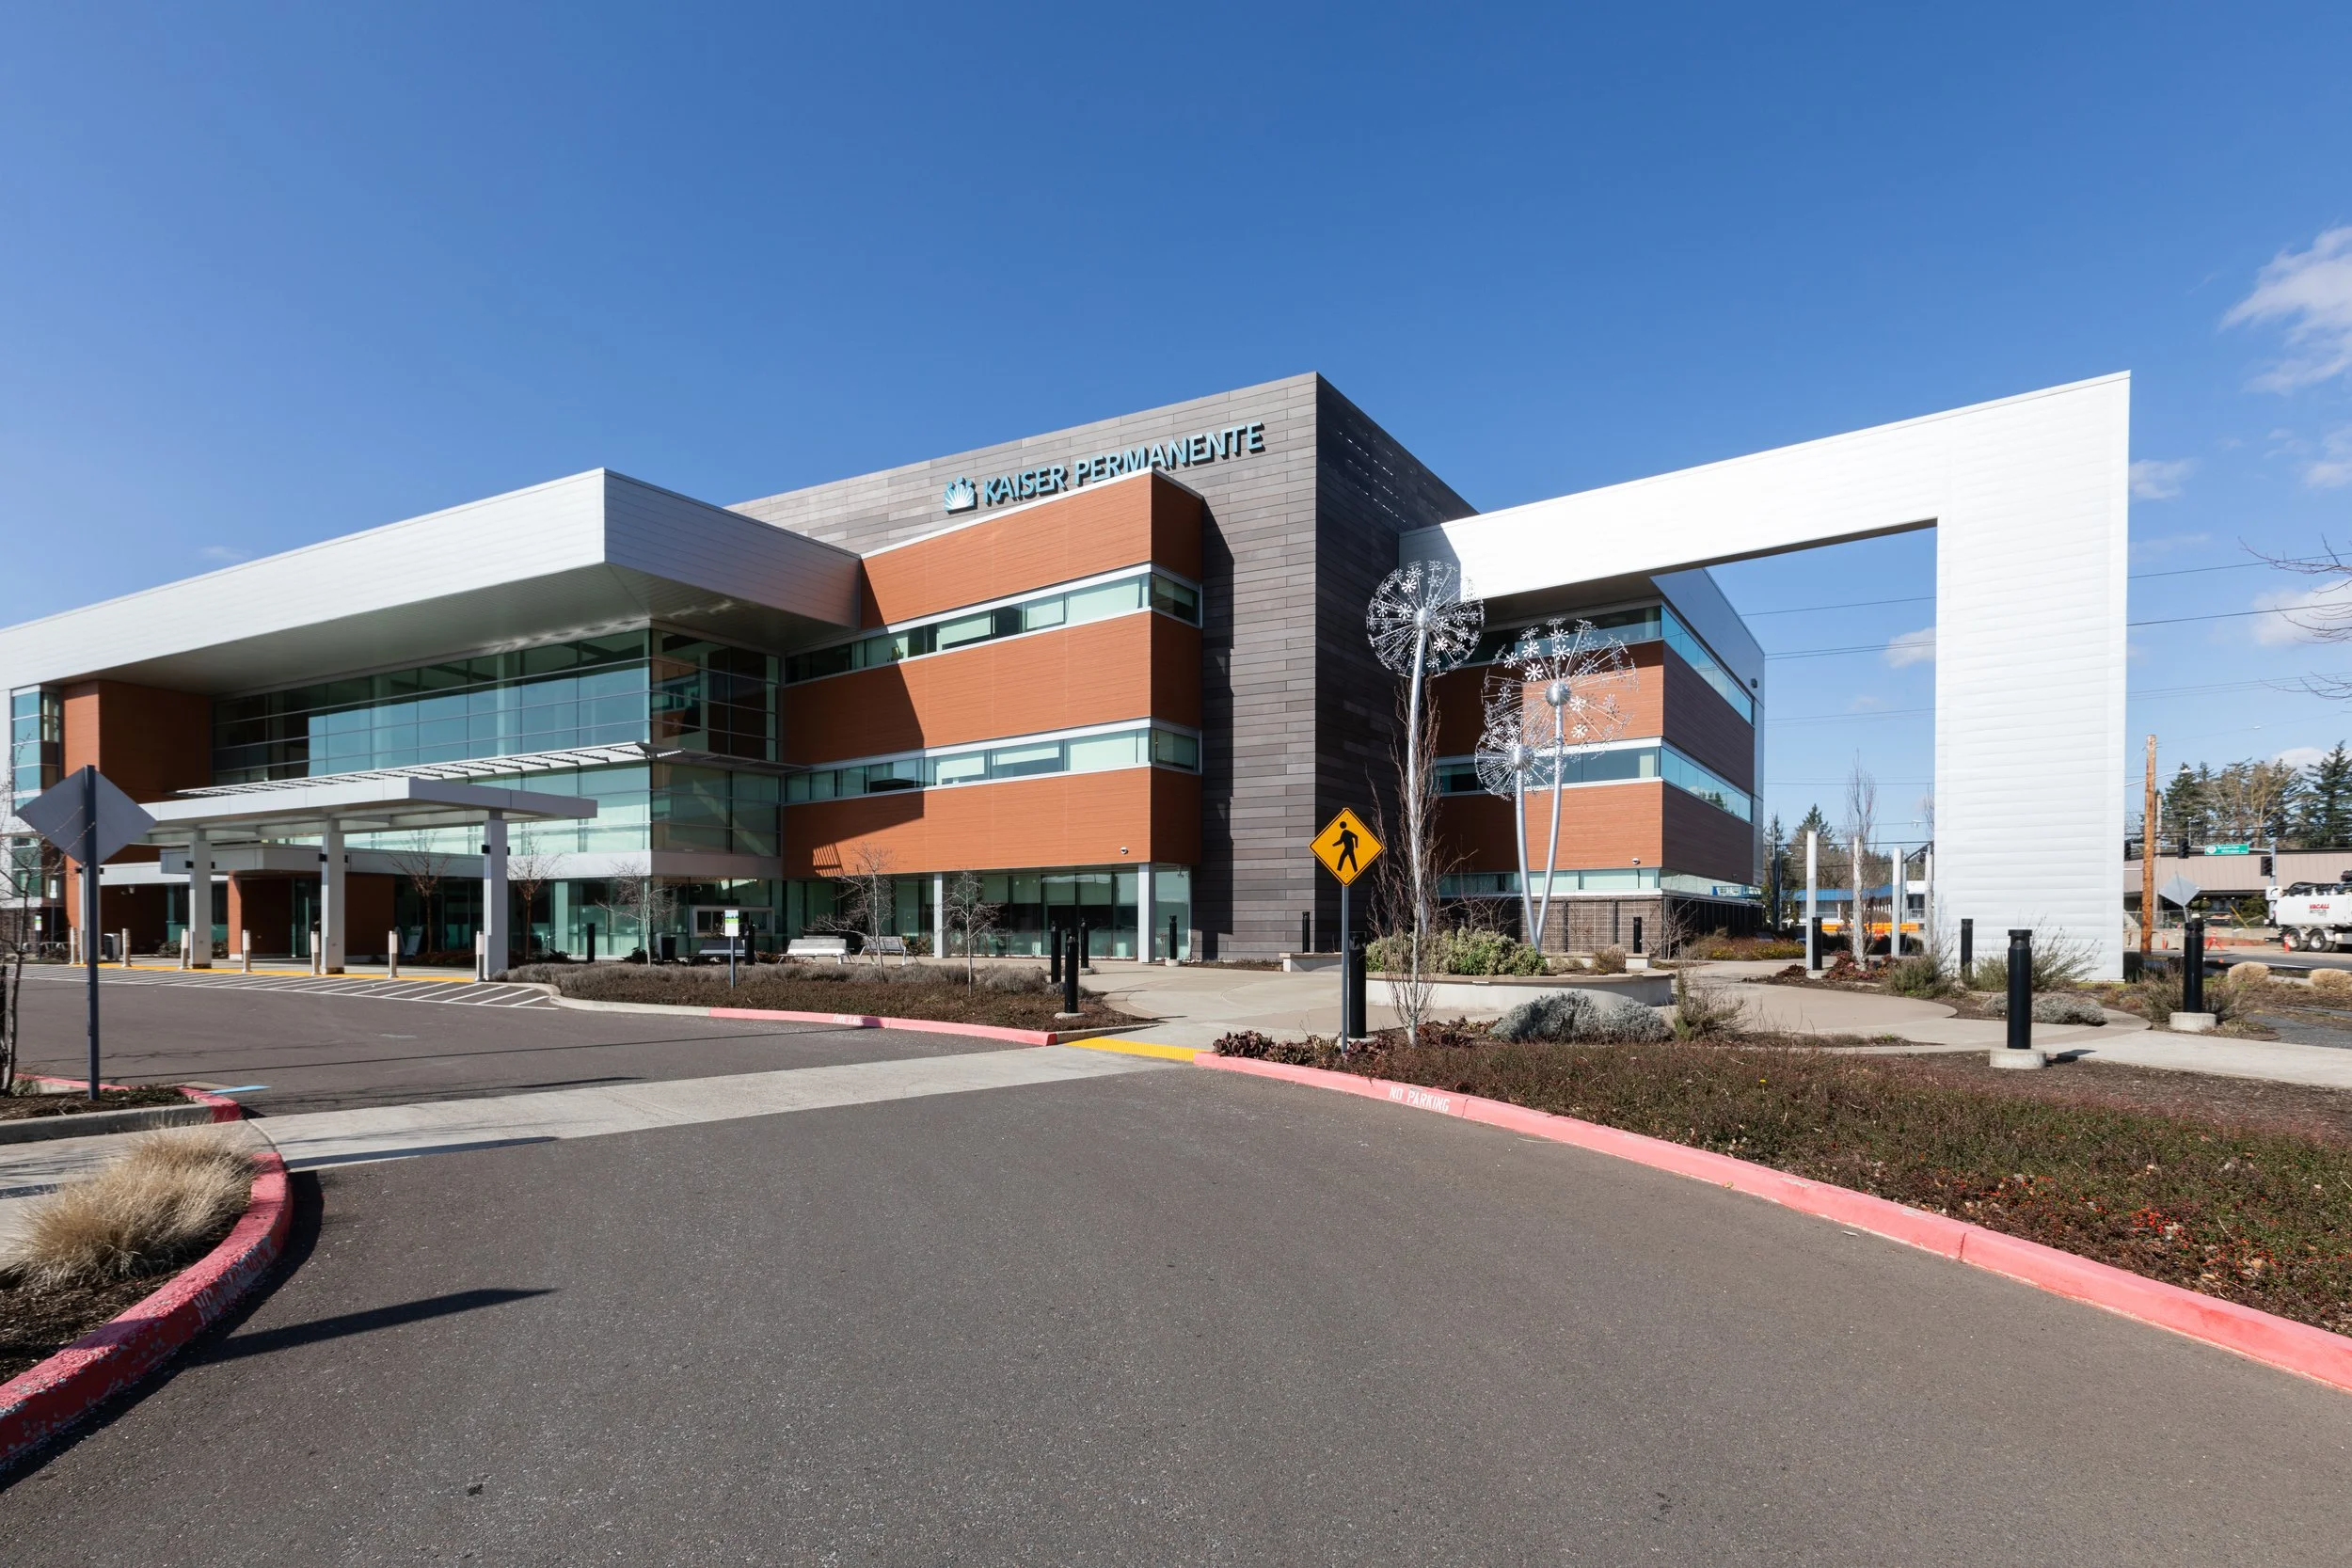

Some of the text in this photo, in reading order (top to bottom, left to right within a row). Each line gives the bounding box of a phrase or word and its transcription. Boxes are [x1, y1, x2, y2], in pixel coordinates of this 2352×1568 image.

[983, 421, 1263, 504] KAISER PERMANENTE
[833, 1015, 847, 1024] FIRE
[1389, 1086, 1451, 1112] NO PARKING
